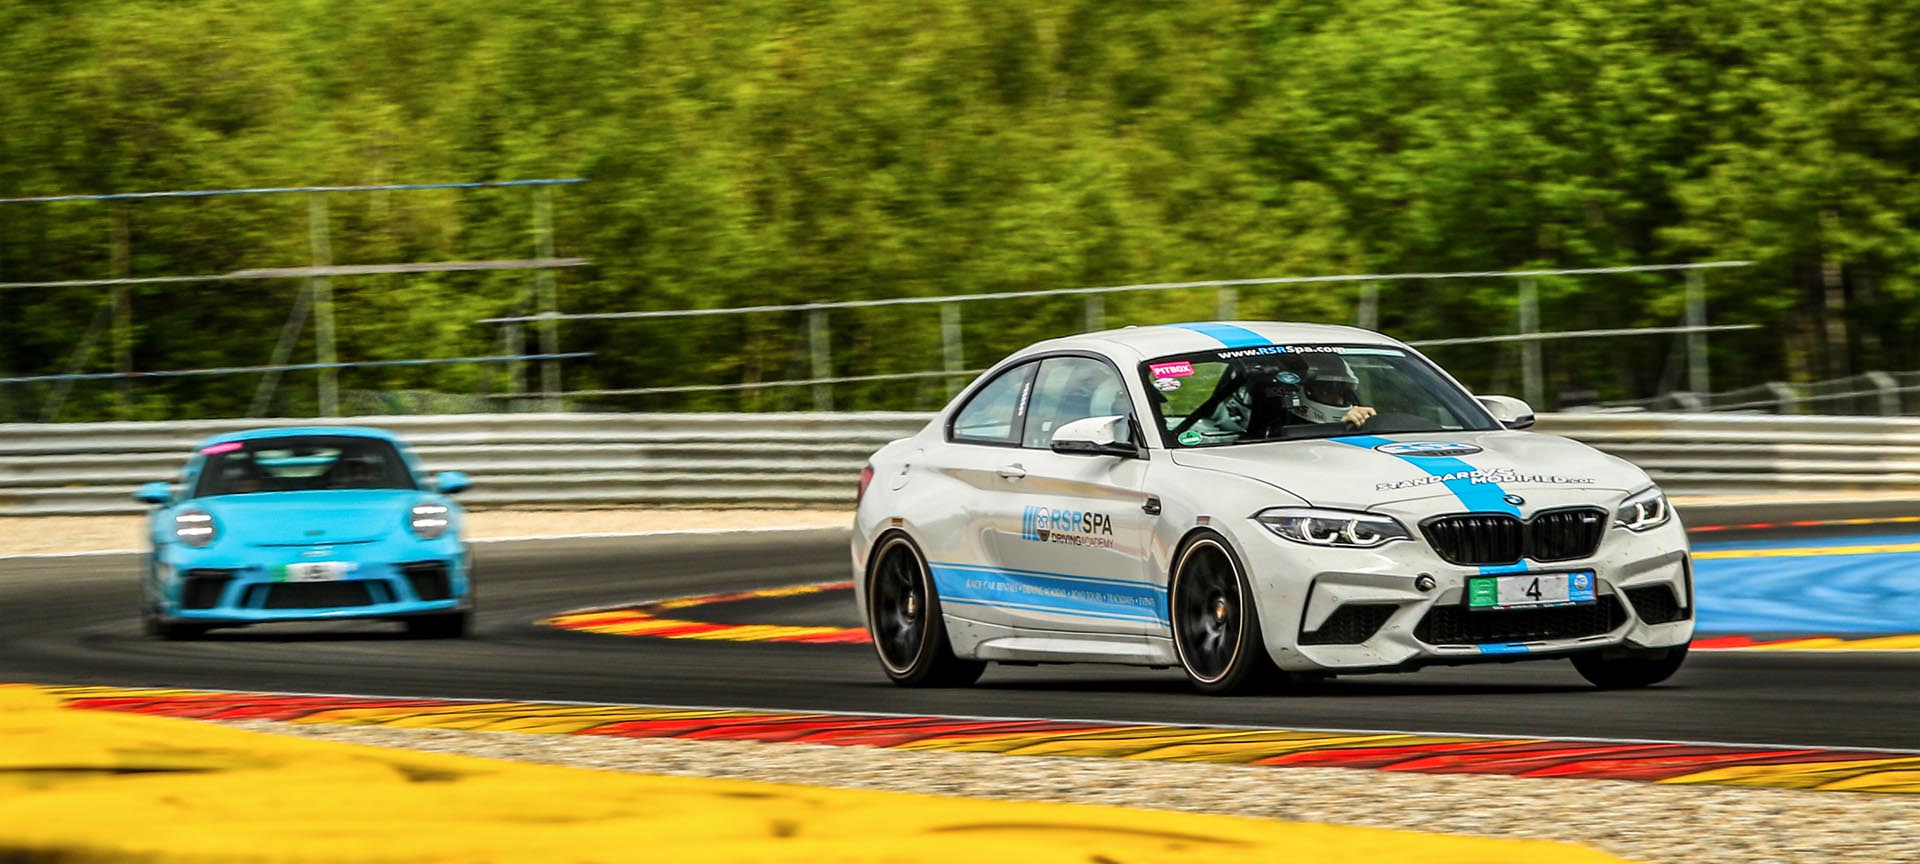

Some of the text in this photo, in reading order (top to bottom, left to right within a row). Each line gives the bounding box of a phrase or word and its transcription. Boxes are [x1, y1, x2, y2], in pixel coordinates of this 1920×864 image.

[1217, 345, 1346, 359] www.RSRSpa.com
[1154, 364, 1191, 375] PITBOX
[1375, 471, 1484, 491] STANDARD
[1526, 577, 1542, 601] 4
